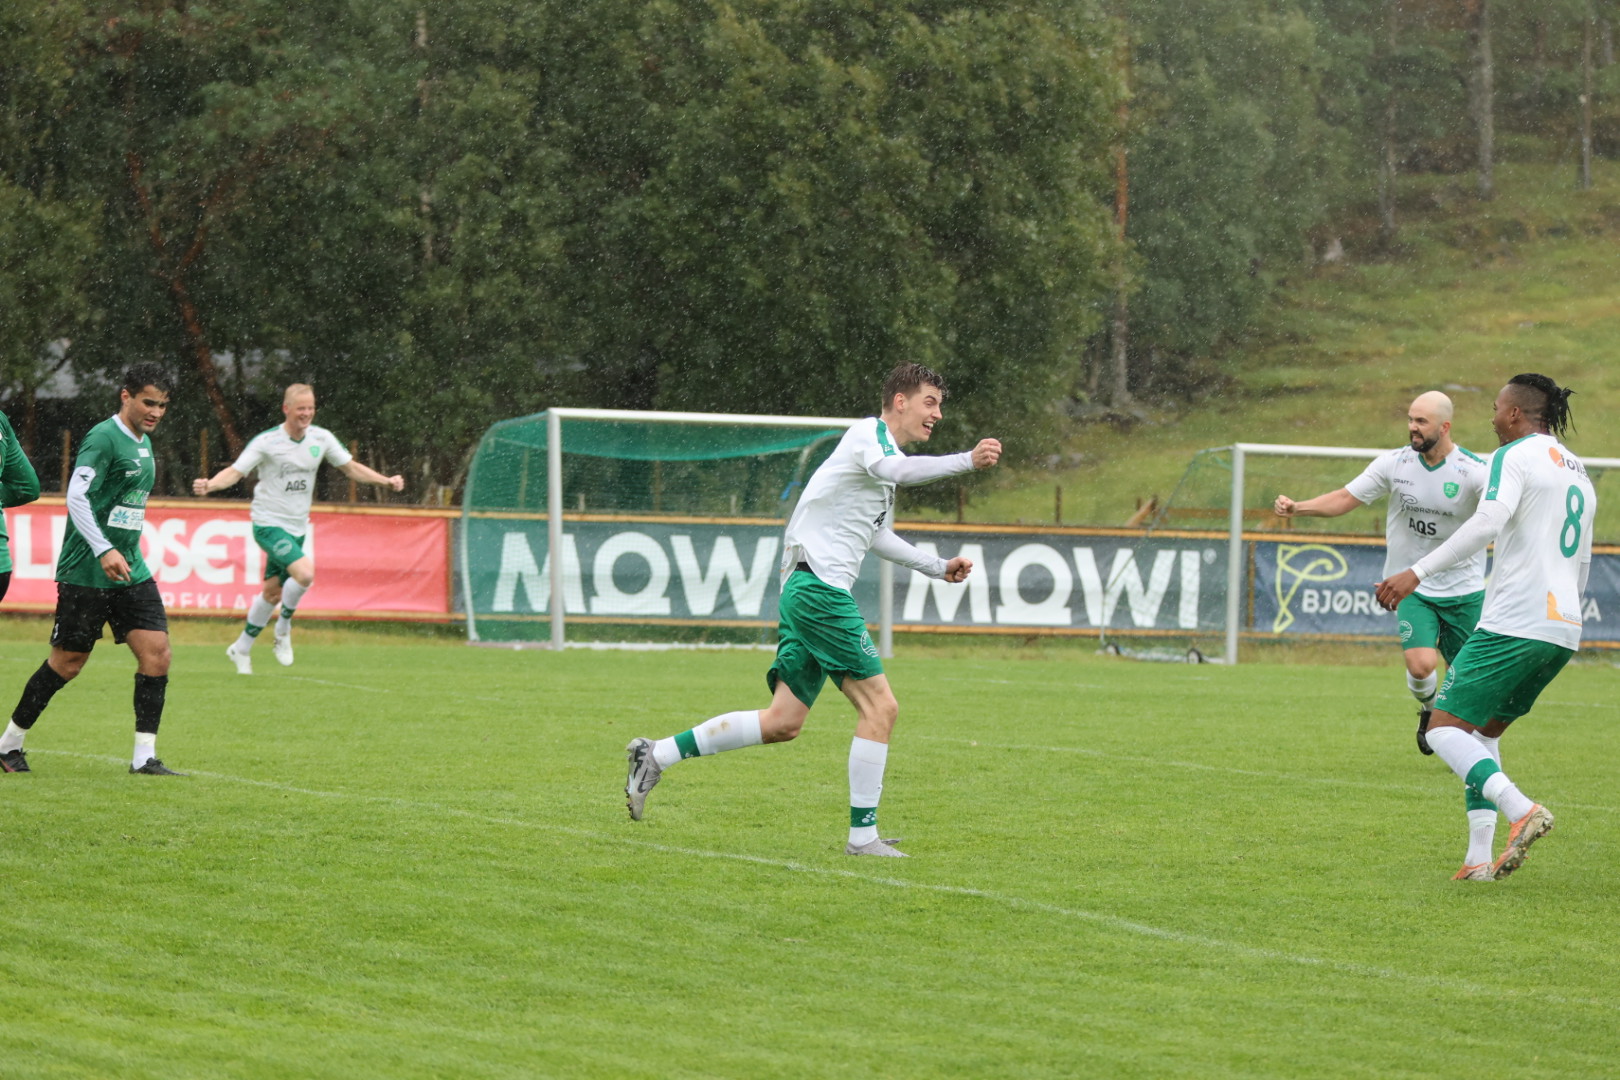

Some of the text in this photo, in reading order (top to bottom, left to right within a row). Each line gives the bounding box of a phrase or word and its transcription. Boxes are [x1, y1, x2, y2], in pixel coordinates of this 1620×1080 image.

[285, 480, 306, 492] AQS
[1409, 517, 1437, 535] AQS
[1559, 484, 1585, 559] 8
[492, 531, 780, 616] MOW
